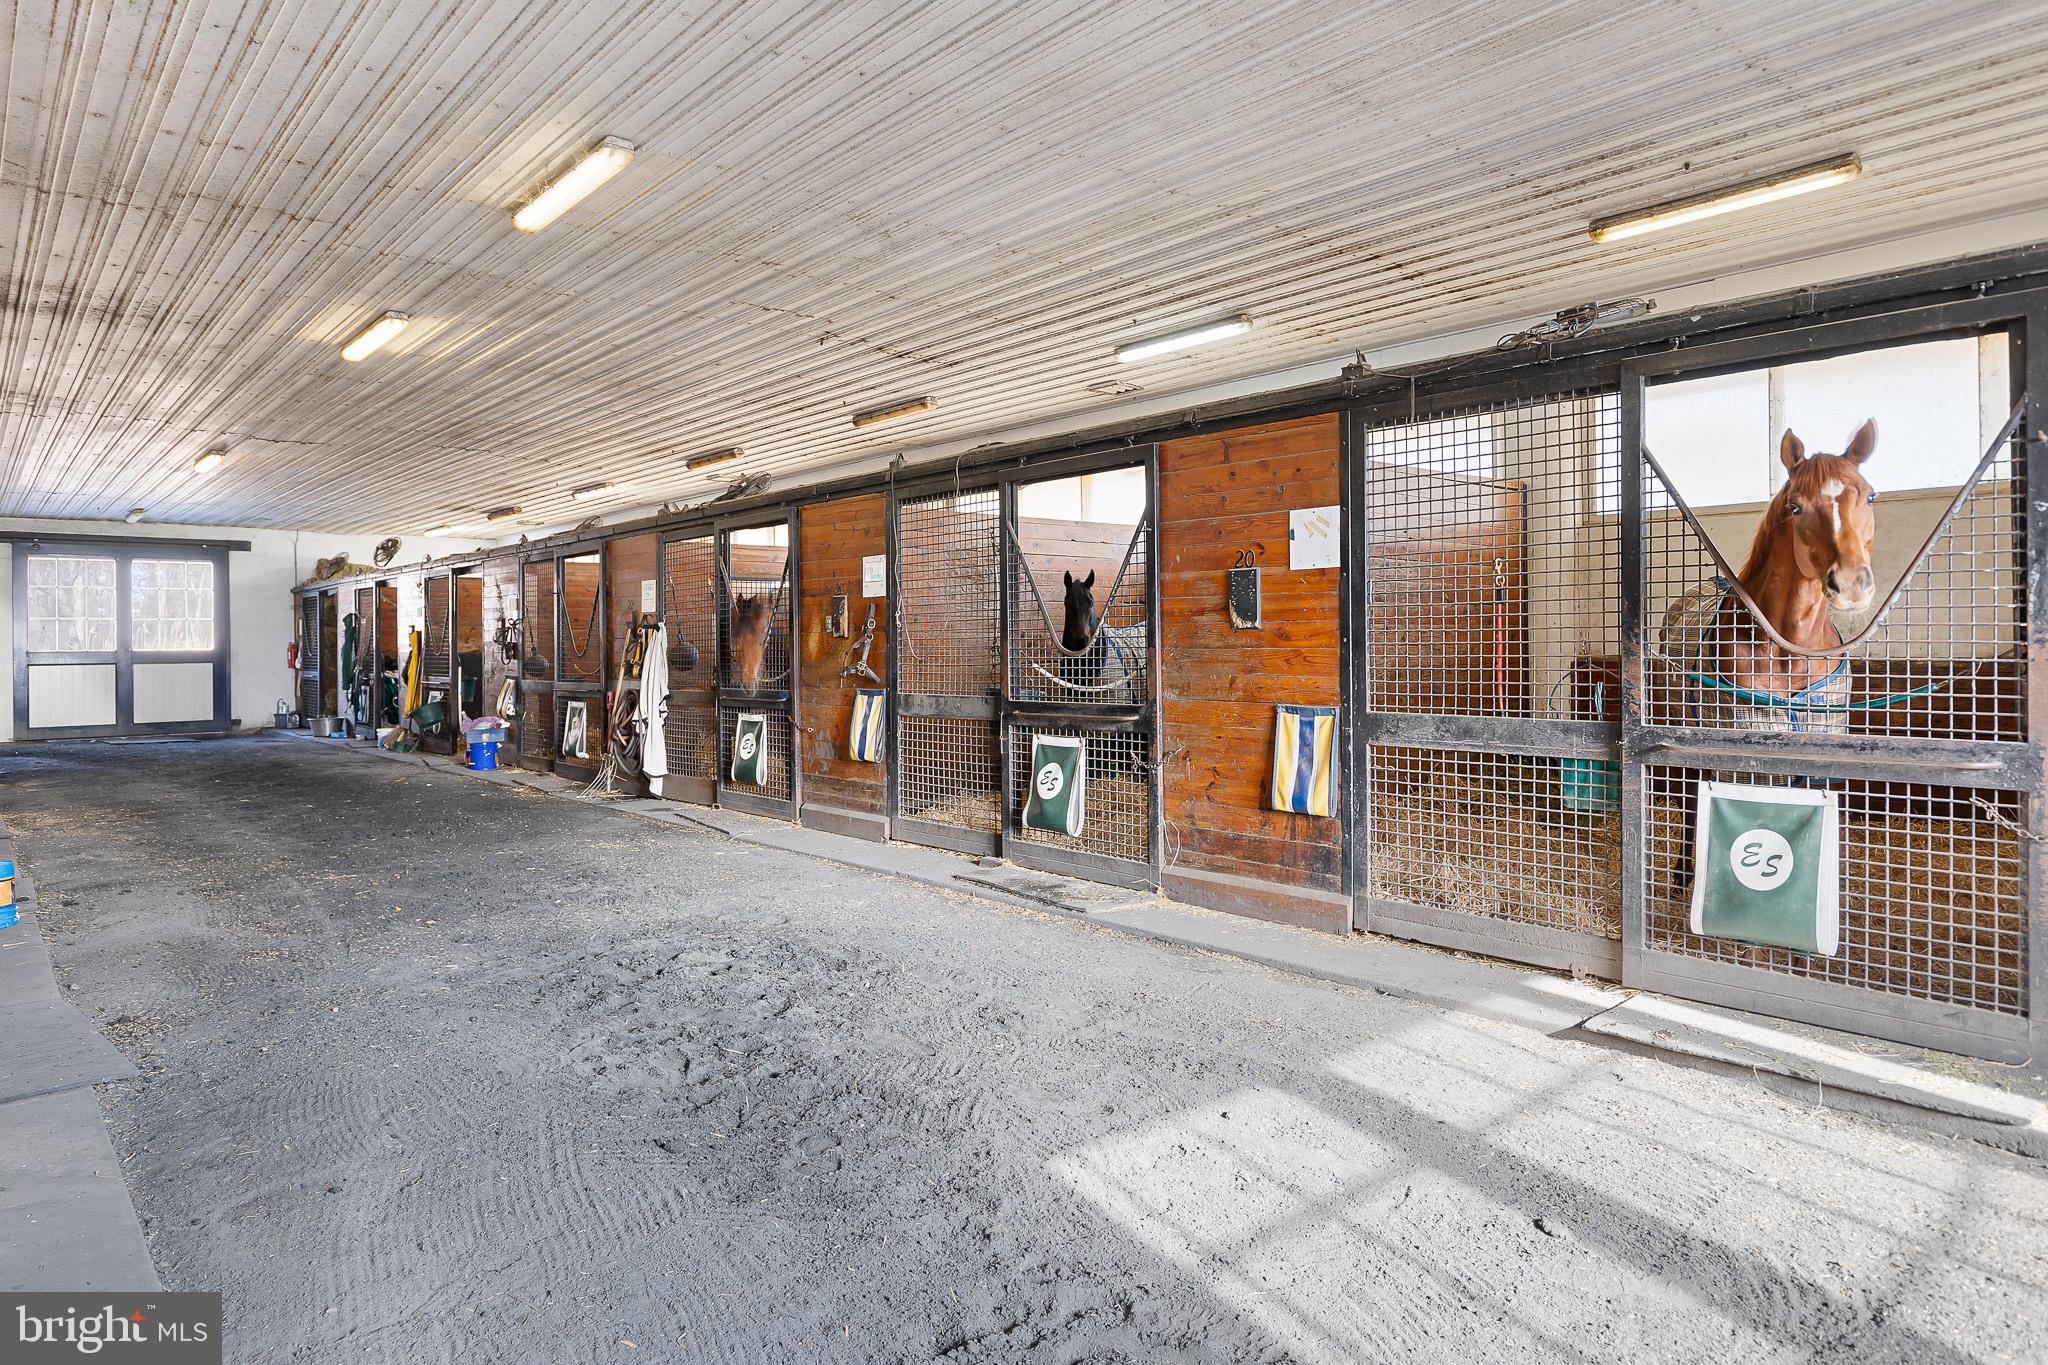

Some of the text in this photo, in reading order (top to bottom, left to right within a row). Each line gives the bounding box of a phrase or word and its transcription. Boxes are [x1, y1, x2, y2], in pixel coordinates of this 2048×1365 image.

[1235, 548, 1256, 568] 20
[1040, 770, 1059, 791] ES
[1740, 842, 1783, 877] ES
